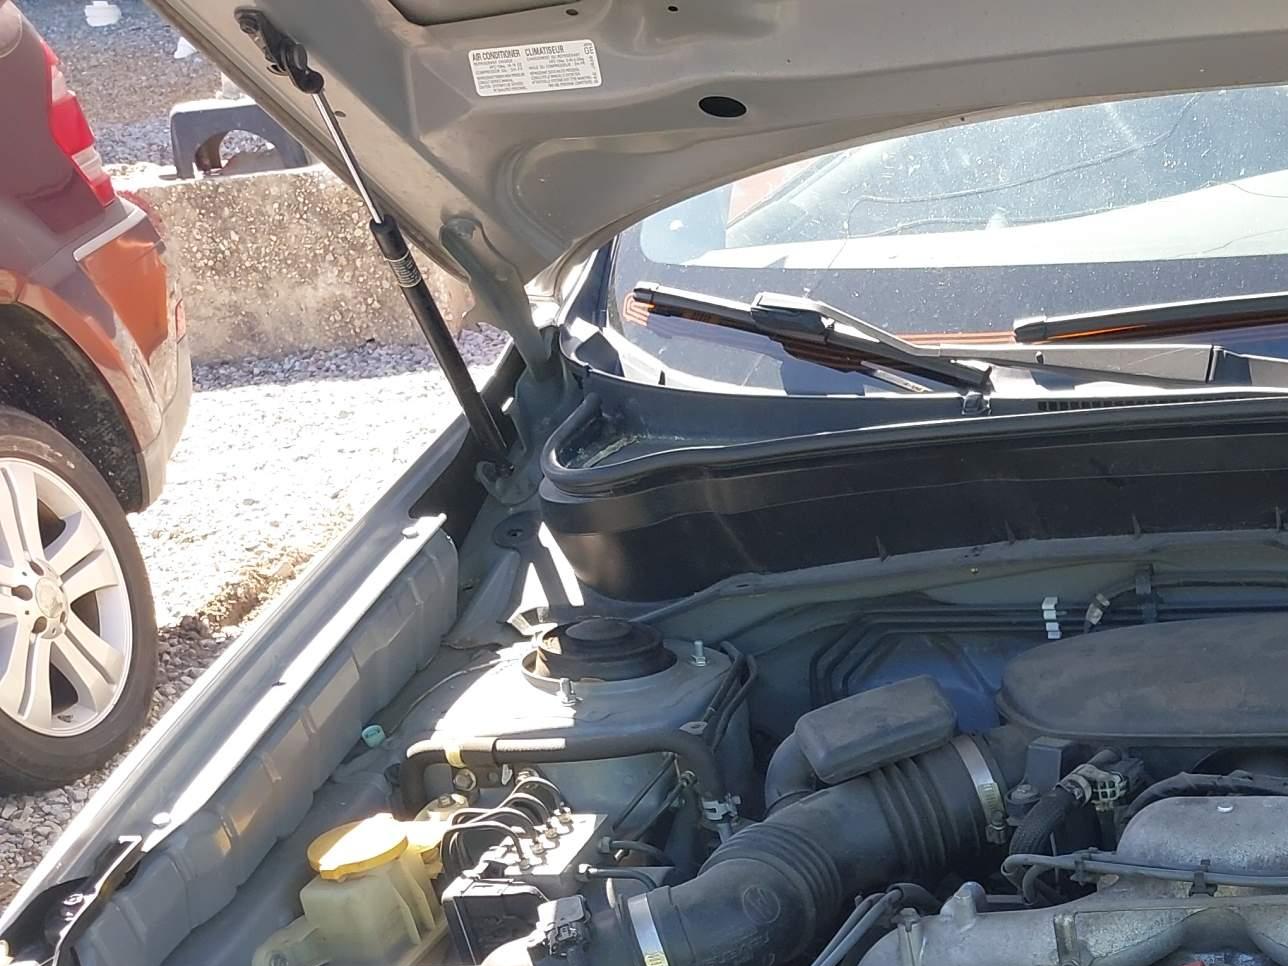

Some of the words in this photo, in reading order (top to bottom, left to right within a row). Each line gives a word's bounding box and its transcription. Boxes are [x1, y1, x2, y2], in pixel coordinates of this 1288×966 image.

[472, 52, 482, 61] AIR
[482, 49, 521, 61] CONDITIONER
[525, 45, 564, 57] CLIMATISEUR
